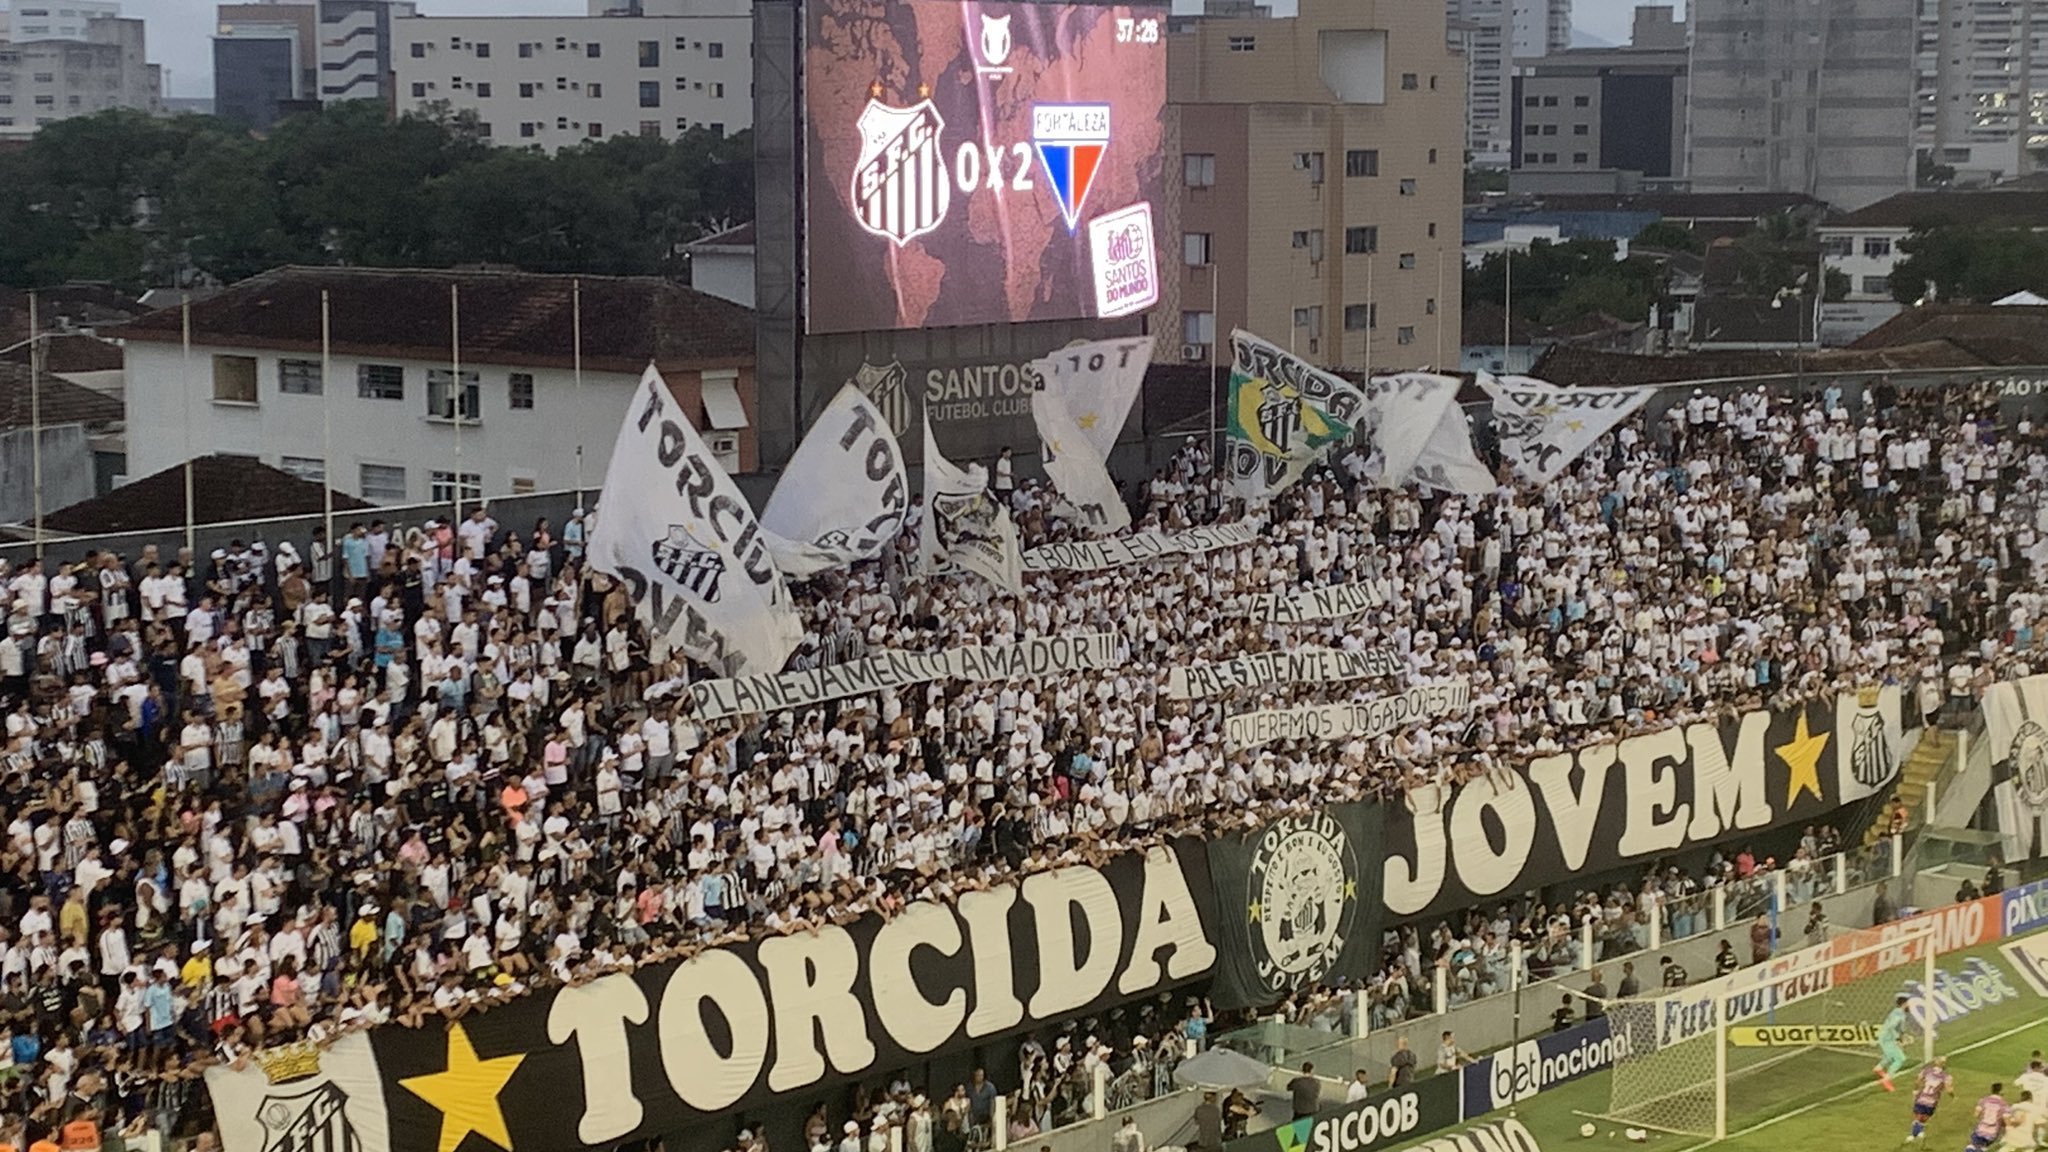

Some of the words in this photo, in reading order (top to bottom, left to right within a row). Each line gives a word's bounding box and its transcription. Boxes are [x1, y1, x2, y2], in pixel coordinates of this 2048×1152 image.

[956, 140, 980, 192] 0
[1012, 141, 1034, 191] 2
[1104, 259, 1147, 289] SANTOS
[1106, 287, 1119, 304] DO
[1119, 276, 1148, 299] MUNDO
[926, 362, 1035, 402] SANTOS
[1040, 543, 1098, 569] BOM
[1099, 542, 1121, 565] E
[1121, 534, 1163, 561] EU
[694, 650, 952, 718] PLANEJAMENTO
[961, 637, 1095, 681] AMADOR
[1230, 709, 1333, 747] QUEREMOS
[1252, 810, 1346, 875] TORCIDA
[1383, 711, 1772, 915] JOVEM
[1258, 932, 1345, 991] JOVEM
[1877, 902, 1985, 972] BETANO
[547, 845, 1217, 1145] TORCIDA
[1313, 1091, 1420, 1152] SICOOB
